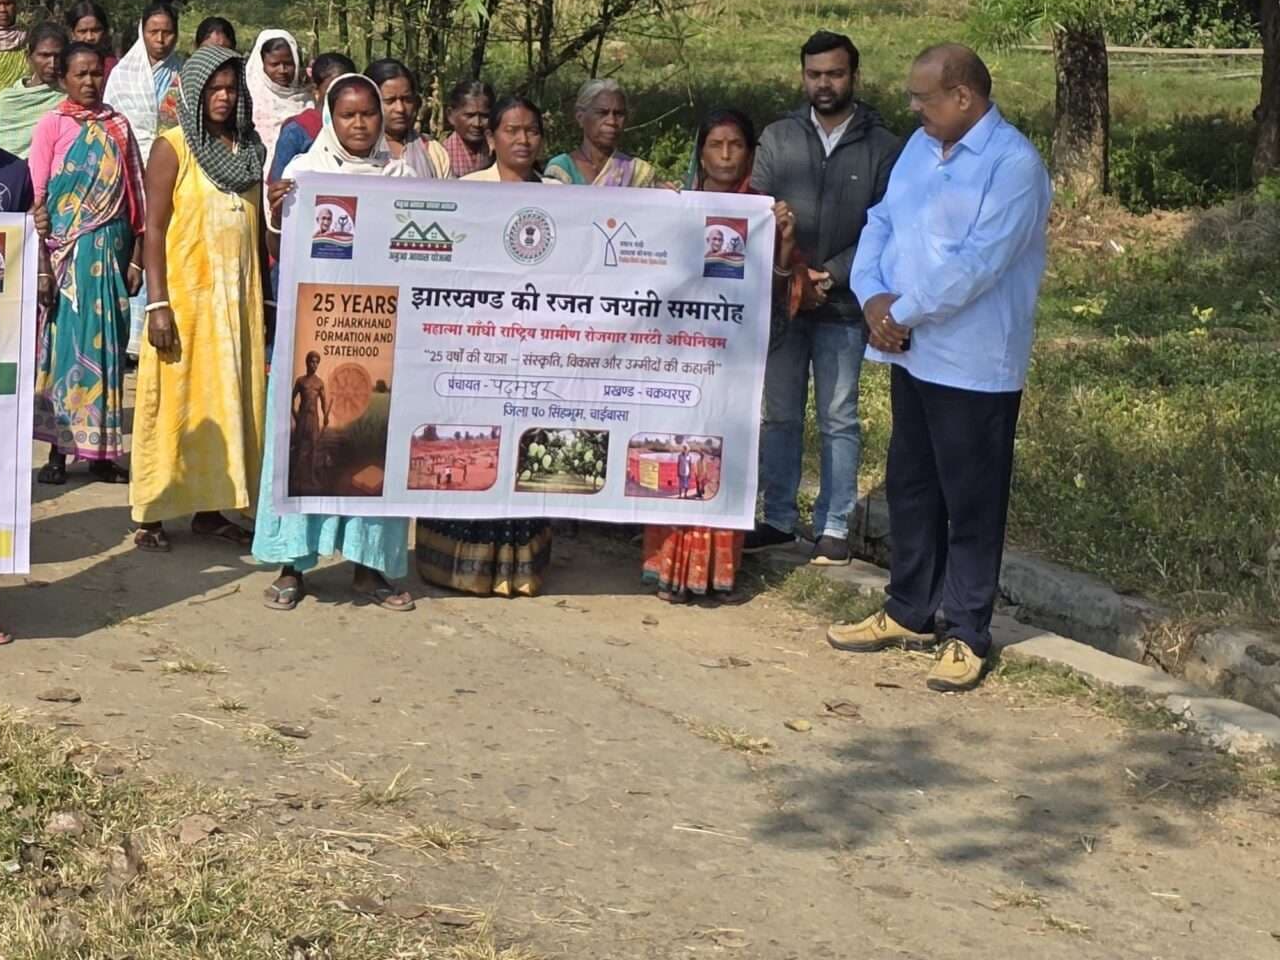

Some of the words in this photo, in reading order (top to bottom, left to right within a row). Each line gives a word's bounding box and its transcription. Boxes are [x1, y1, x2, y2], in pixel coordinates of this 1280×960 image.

[313, 293, 335, 312] 25
[341, 294, 397, 314] YEARS
[412, 287, 504, 310] झारखण्ड
[511, 282, 540, 311] की
[546, 293, 594, 314] रजत
[600, 290, 662, 318] जयंती
[667, 294, 744, 324] समारोह
[316, 316, 329, 327] OF
[332, 317, 392, 329] JHARKHAND
[314, 330, 370, 343] FORMATION
[373, 332, 393, 344] AND
[422, 322, 462, 336] महात्मा
[466, 320, 496, 337] गाँधी
[540, 323, 580, 341] ग्रामीण
[585, 326, 627, 344] रोजगार
[630, 328, 662, 346] गारंटी
[666, 330, 728, 350] अधिनियम
[324, 345, 379, 357] STATEHOOD
[446, 347, 464, 364] वर्षों
[466, 348, 480, 364] की
[483, 352, 508, 365] यात्रा
[567, 353, 600, 369] विकास
[602, 354, 621, 370] और
[625, 356, 660, 372] उम्मीदों
[664, 358, 678, 373] की
[448, 376, 480, 391] पंचायत
[604, 384, 634, 397] प्रखण्ड
[503, 402, 528, 417] जिला
